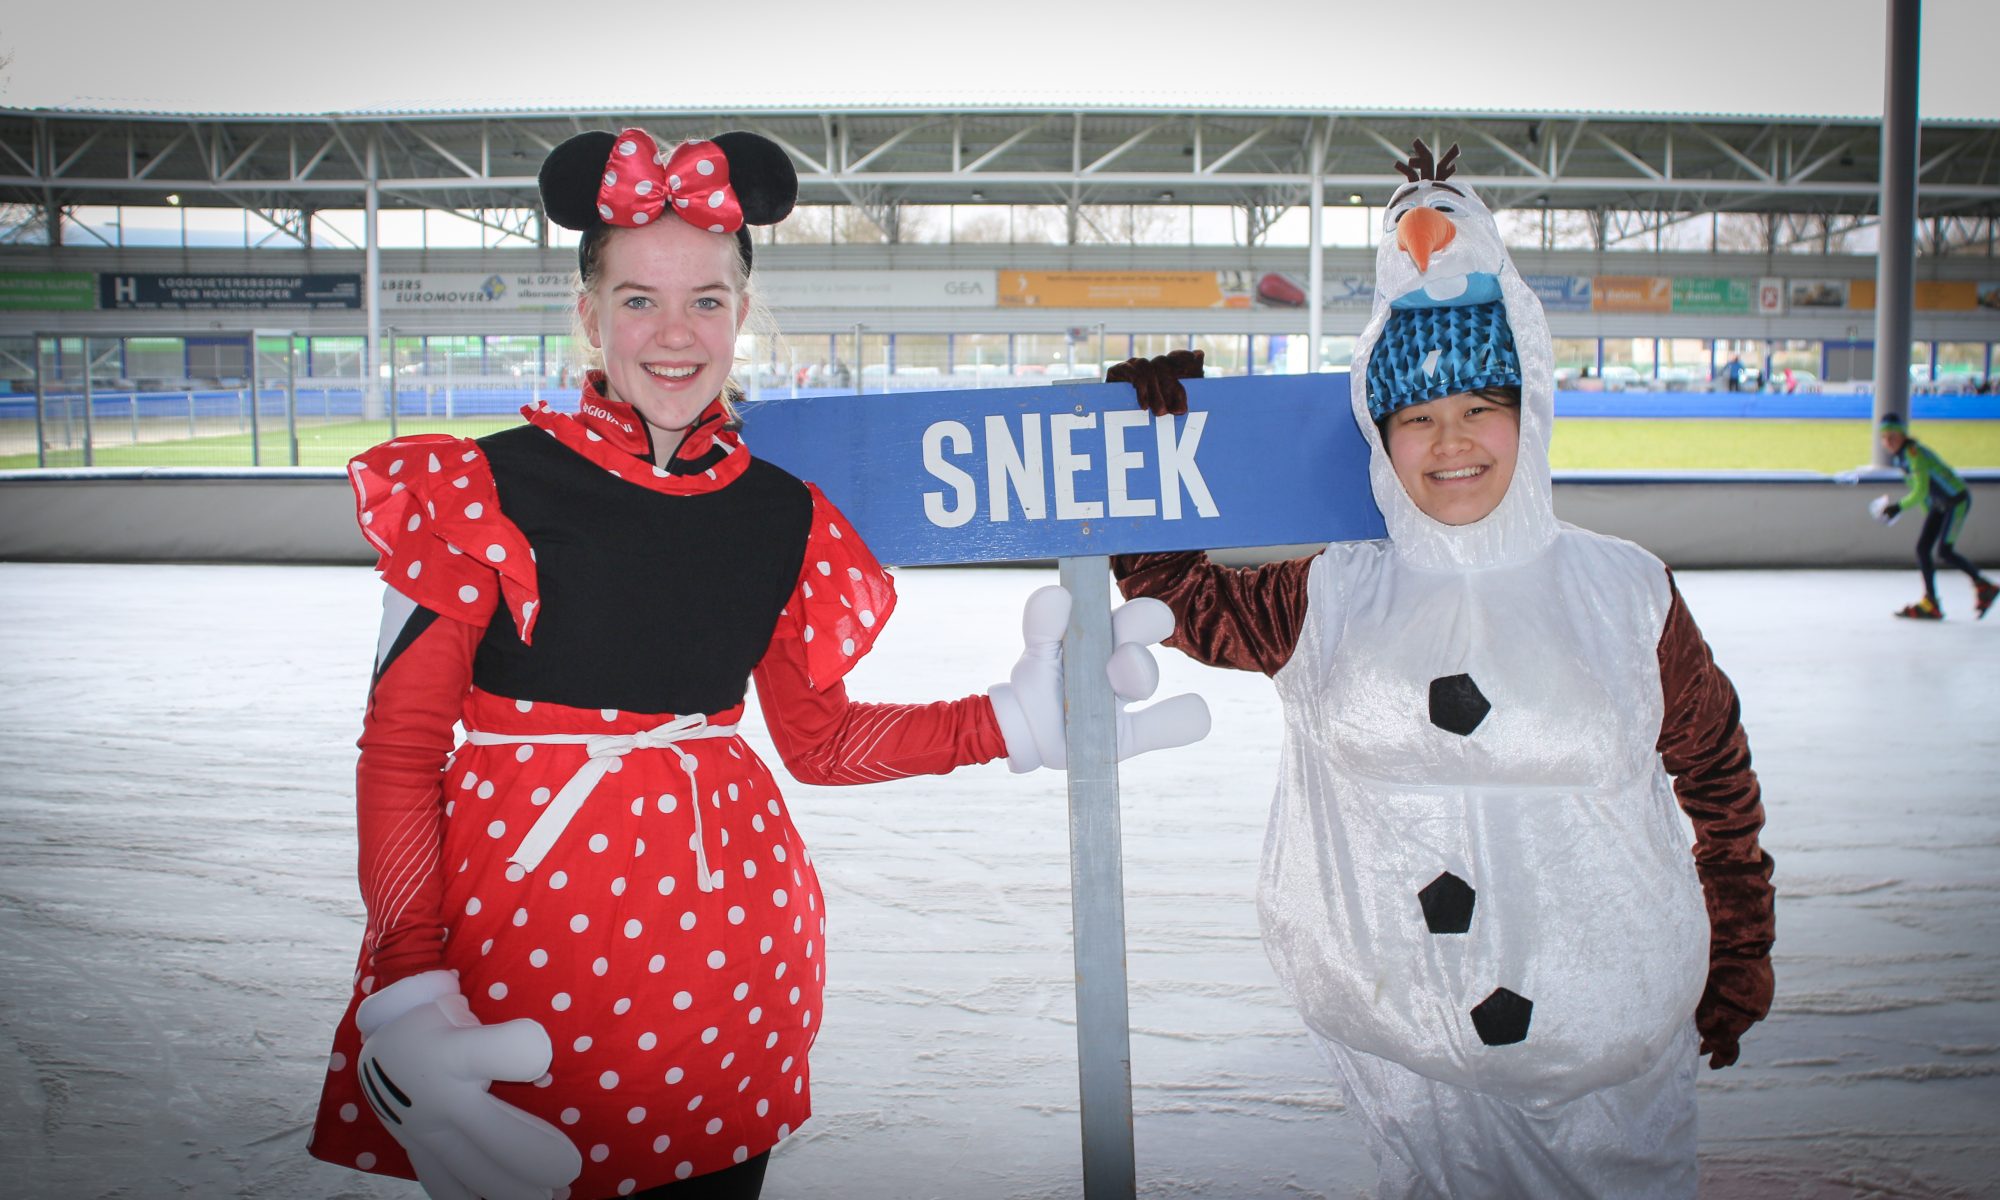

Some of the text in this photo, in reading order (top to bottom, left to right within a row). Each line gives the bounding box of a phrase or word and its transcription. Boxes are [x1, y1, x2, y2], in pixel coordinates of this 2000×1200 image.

[115, 277, 136, 301] H
[158, 278, 302, 288] LOODGIETERSBEDRIJF
[381, 280, 421, 290] LBERS
[944, 281, 983, 295] GEA
[172, 289, 290, 299] ROB HOUTKOOPER
[922, 410, 1220, 528] SNEEK
